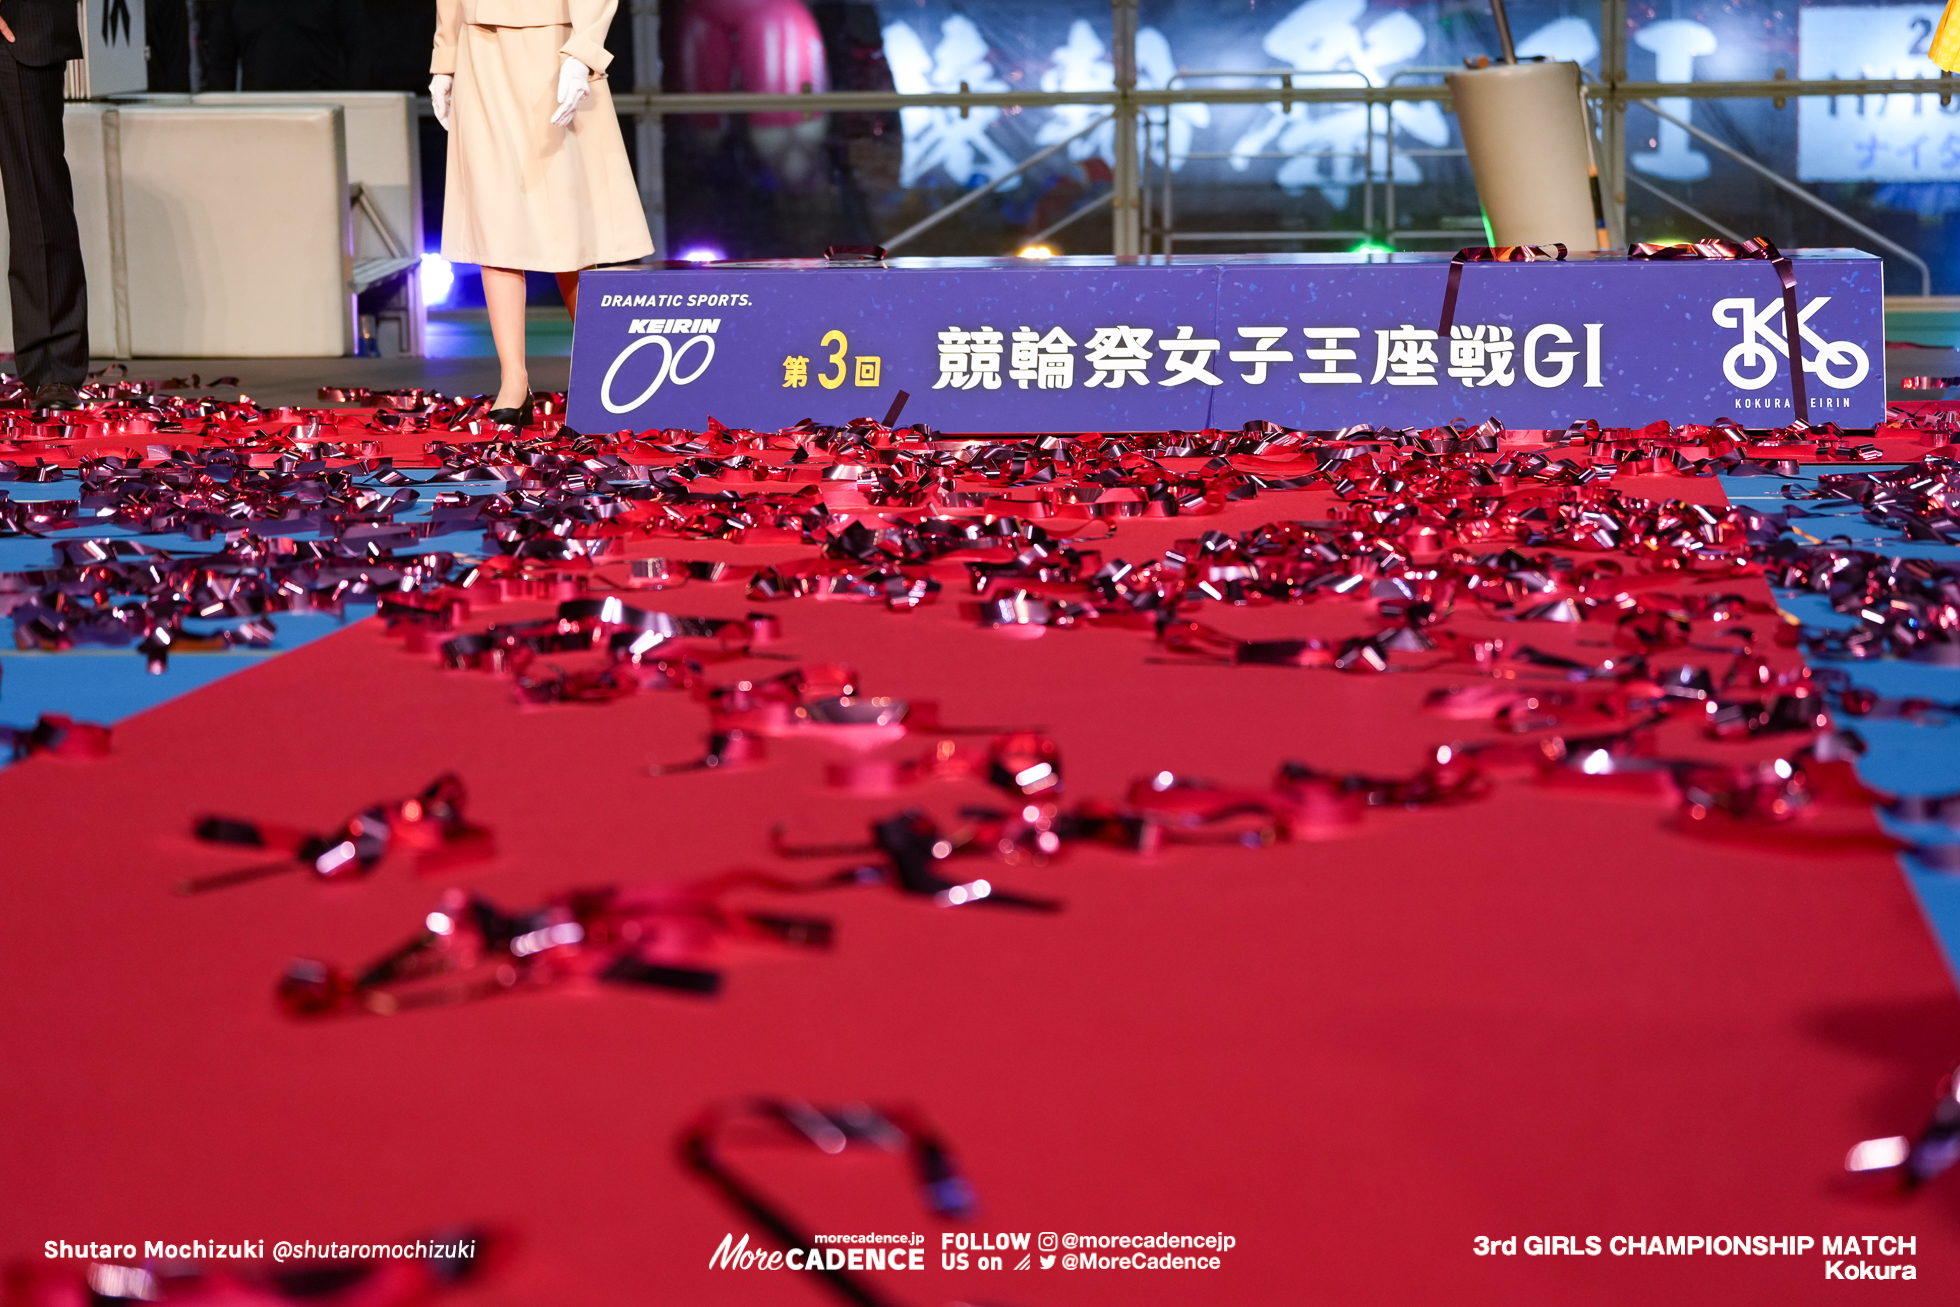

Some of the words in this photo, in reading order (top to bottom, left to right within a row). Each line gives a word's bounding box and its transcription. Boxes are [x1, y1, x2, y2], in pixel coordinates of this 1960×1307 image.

[600, 294, 683, 307] DRAMATIC
[686, 293, 753, 307] SPORTS.
[628, 319, 722, 334] KEIRIN
[782, 329, 882, 389] 第3回
[1735, 398, 1791, 409] KOKURA
[1802, 397, 1850, 408] EIRIN
